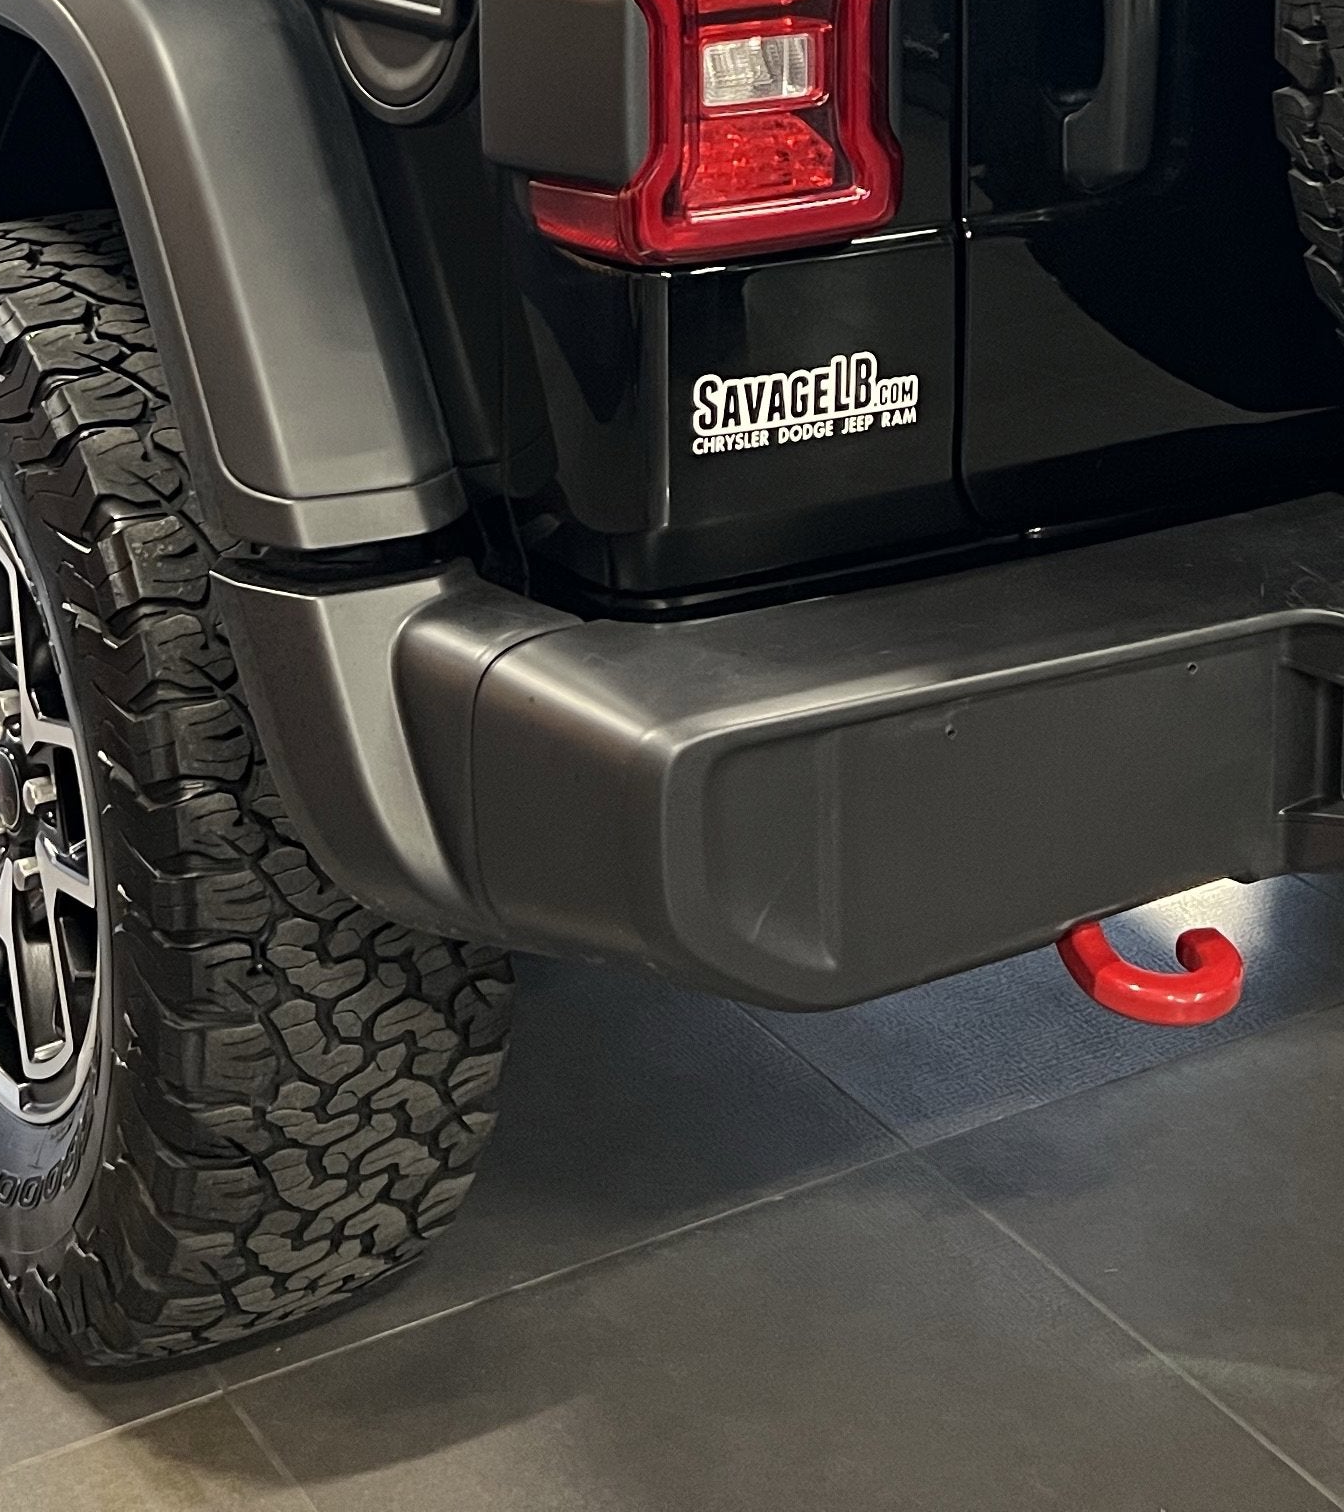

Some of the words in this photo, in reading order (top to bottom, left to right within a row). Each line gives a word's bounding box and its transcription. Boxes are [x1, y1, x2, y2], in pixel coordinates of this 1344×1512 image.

[692, 431, 769, 456] CHRYSLER
[778, 419, 834, 445] DODGE
[841, 413, 874, 435] JEEP
[880, 405, 917, 428] RAM
